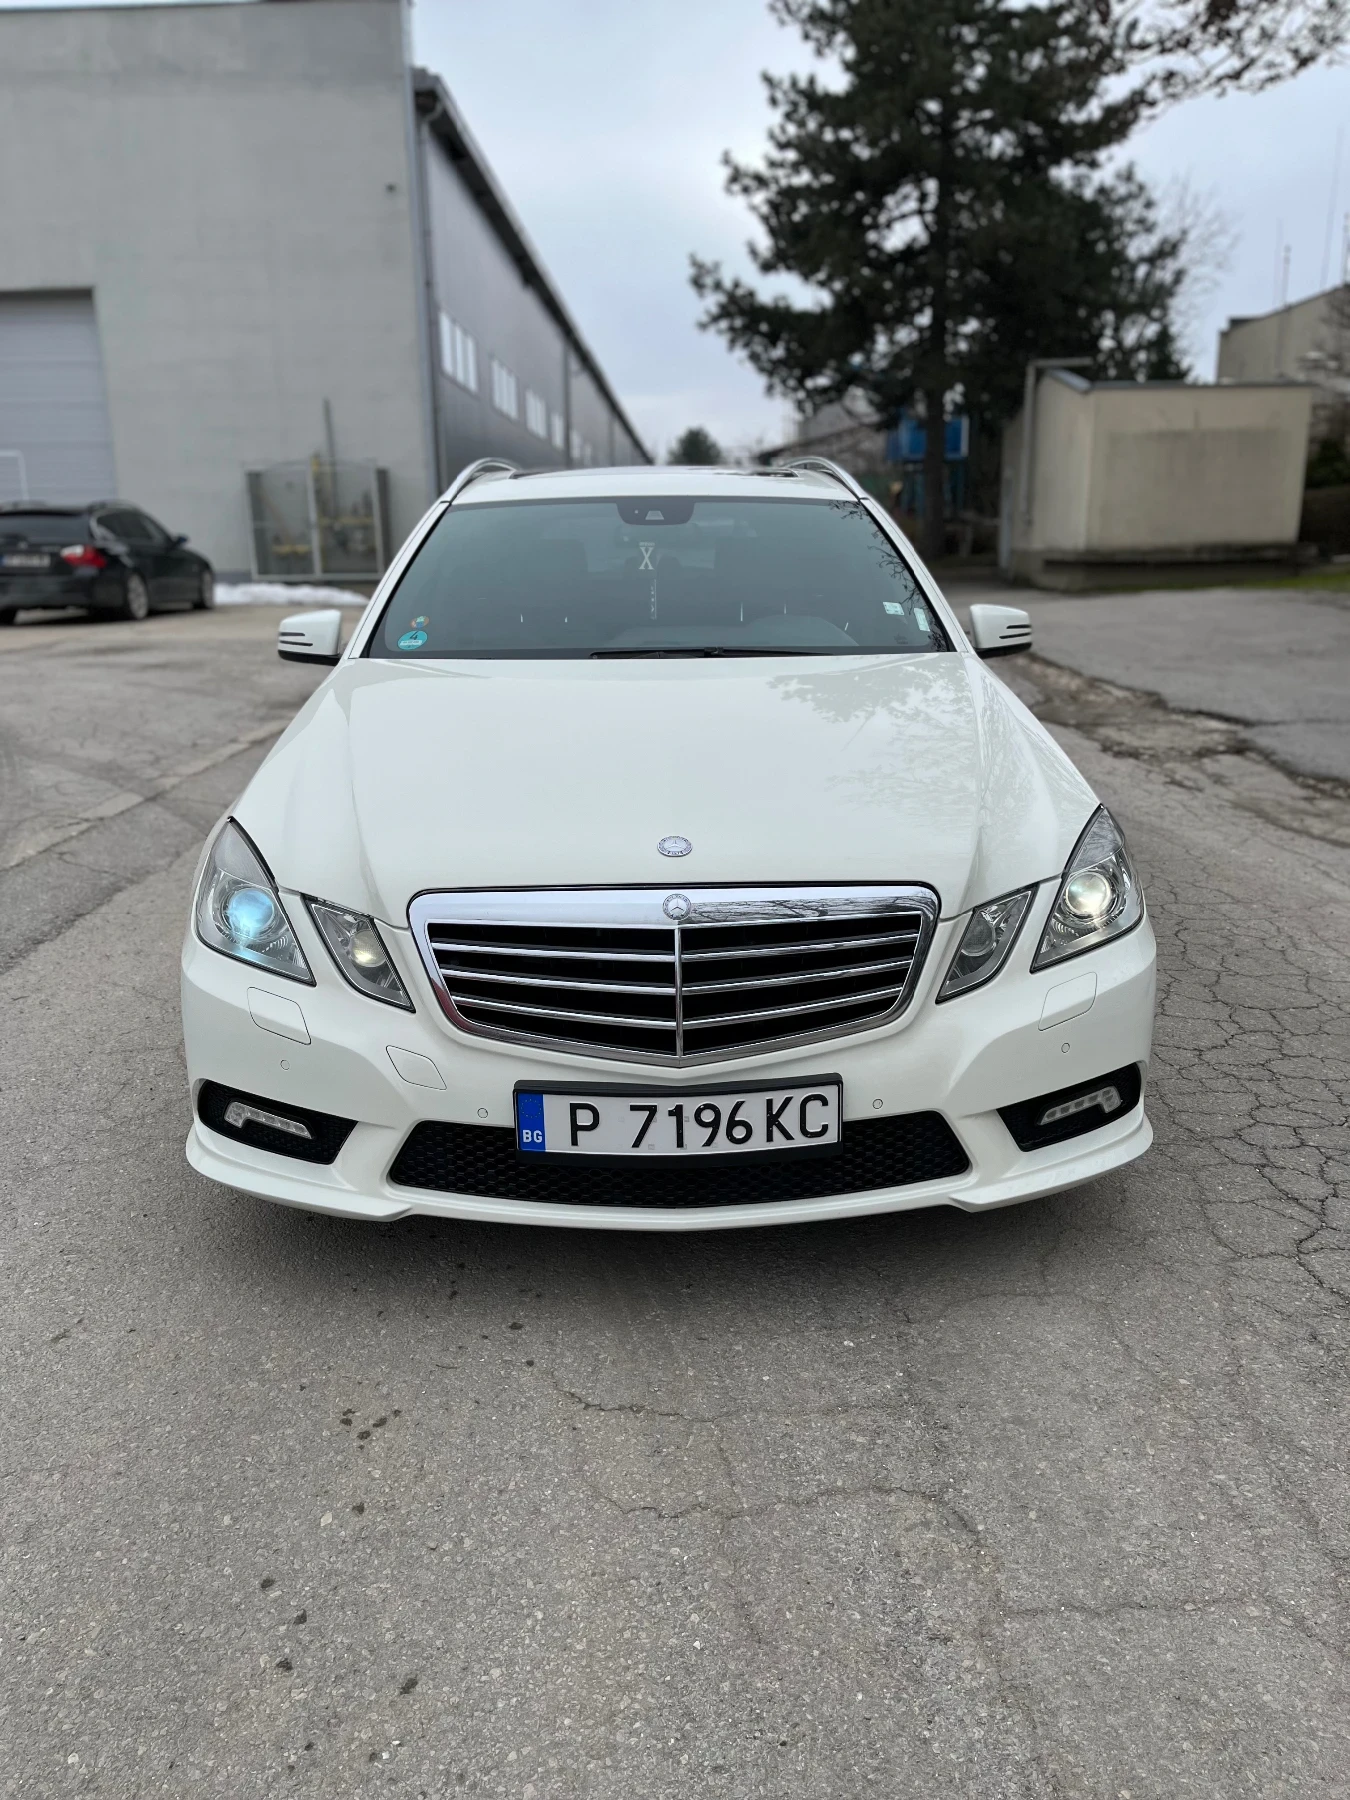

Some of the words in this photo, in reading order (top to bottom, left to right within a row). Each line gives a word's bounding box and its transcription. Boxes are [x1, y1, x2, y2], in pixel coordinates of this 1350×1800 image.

[638, 546, 655, 570] X
[569, 1102, 600, 1146] P
[629, 1100, 753, 1149] 7196
[765, 1093, 829, 1143] KC
[522, 1130, 543, 1143] BG
